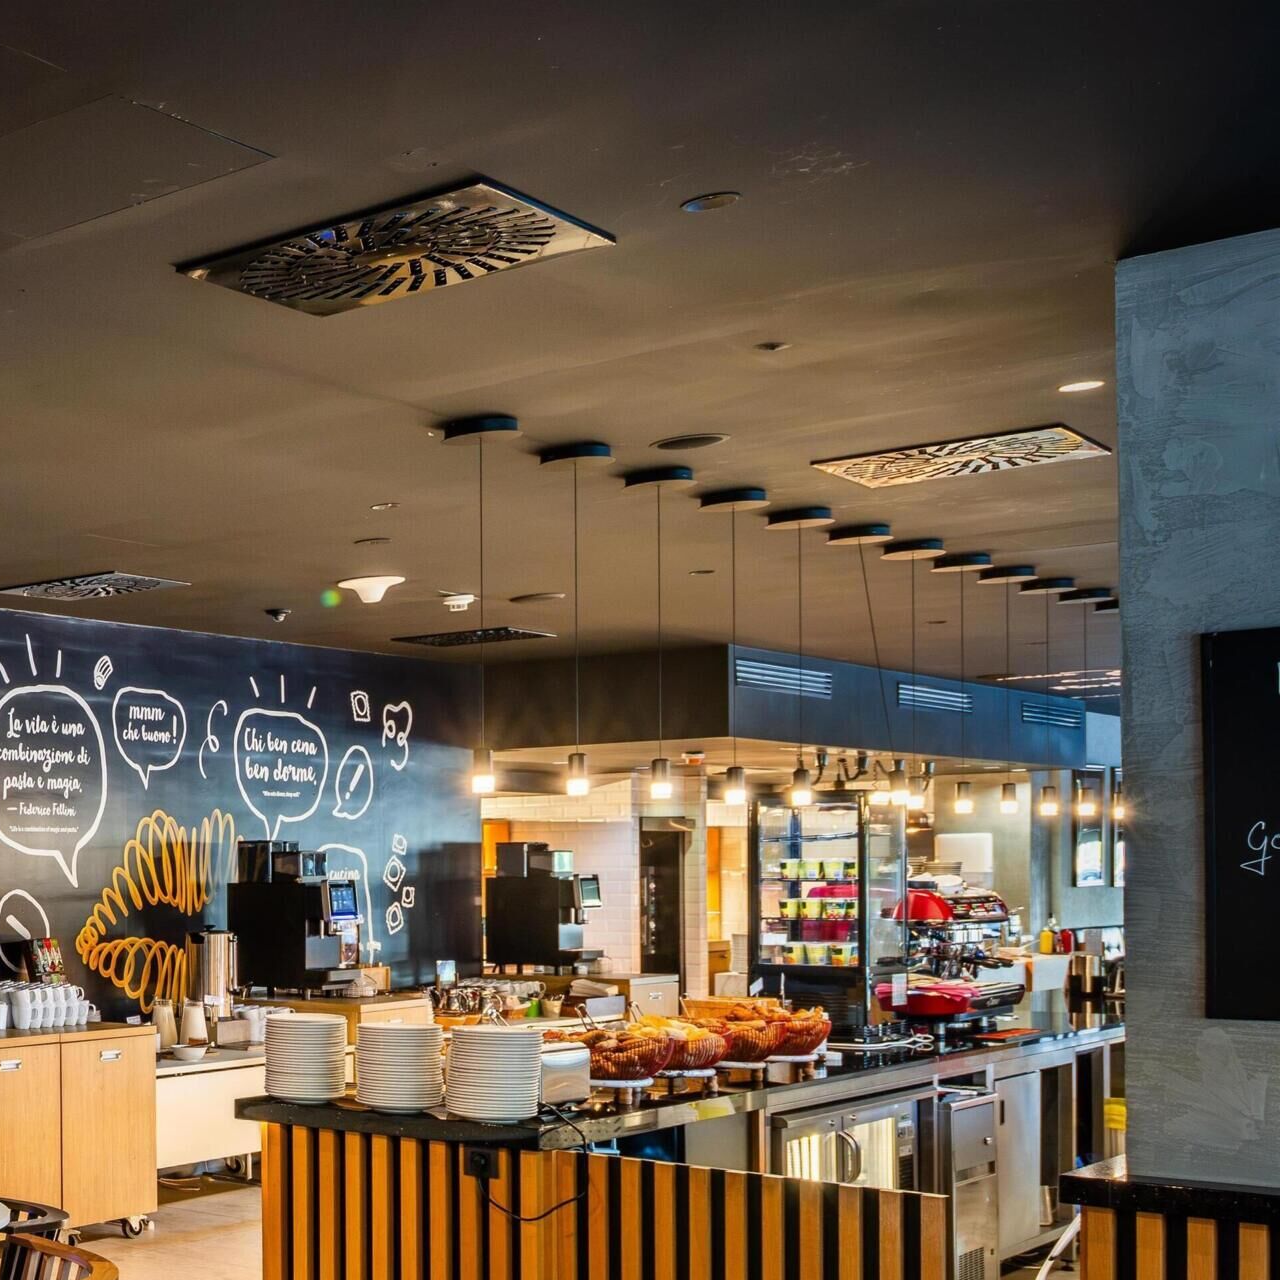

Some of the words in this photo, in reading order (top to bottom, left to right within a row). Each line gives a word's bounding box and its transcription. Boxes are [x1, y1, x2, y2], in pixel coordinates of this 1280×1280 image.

[6, 707, 24, 739] La
[25, 714, 50, 735] vita
[61, 721, 86, 738] una
[129, 705, 166, 722] mmm
[122, 721, 141, 742] che
[245, 728, 266, 753] Chi
[268, 732, 287, 754] ben
[292, 740, 317, 756] cena
[77, 746, 91, 766] di
[245, 756, 269, 783] ben
[2, 771, 36, 801] pasta
[37, 776, 45, 789] e
[19, 801, 51, 817] Federico
[52, 802, 77, 817] Fellini
[328, 866, 361, 880] cucina
